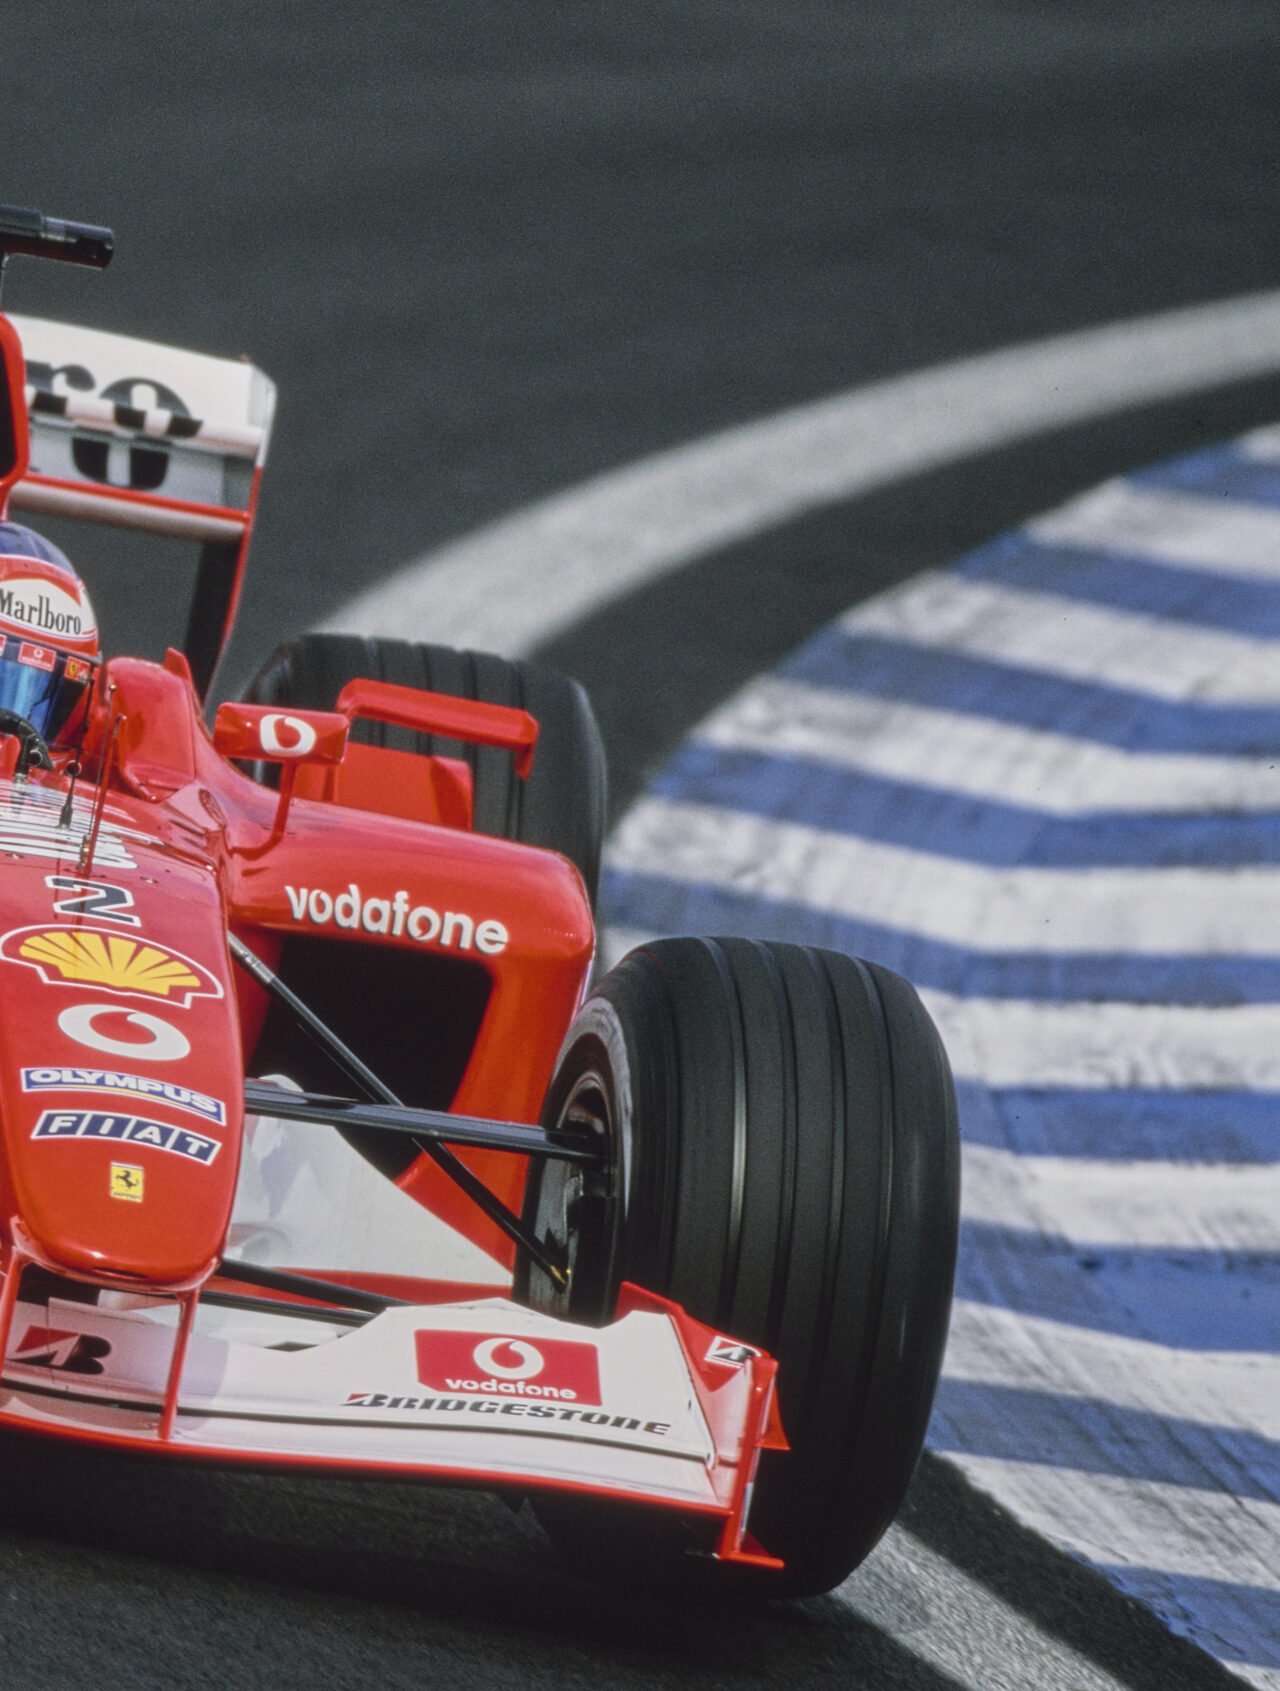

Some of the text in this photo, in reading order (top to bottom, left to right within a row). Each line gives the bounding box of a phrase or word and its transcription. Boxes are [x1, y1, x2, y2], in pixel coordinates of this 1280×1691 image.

[46, 875, 142, 926] 2
[285, 884, 509, 955] vodafone
[30, 1068, 219, 1114] OLYMPUS
[48, 1115, 210, 1155] FIAT
[445, 1377, 577, 1400] vodafone
